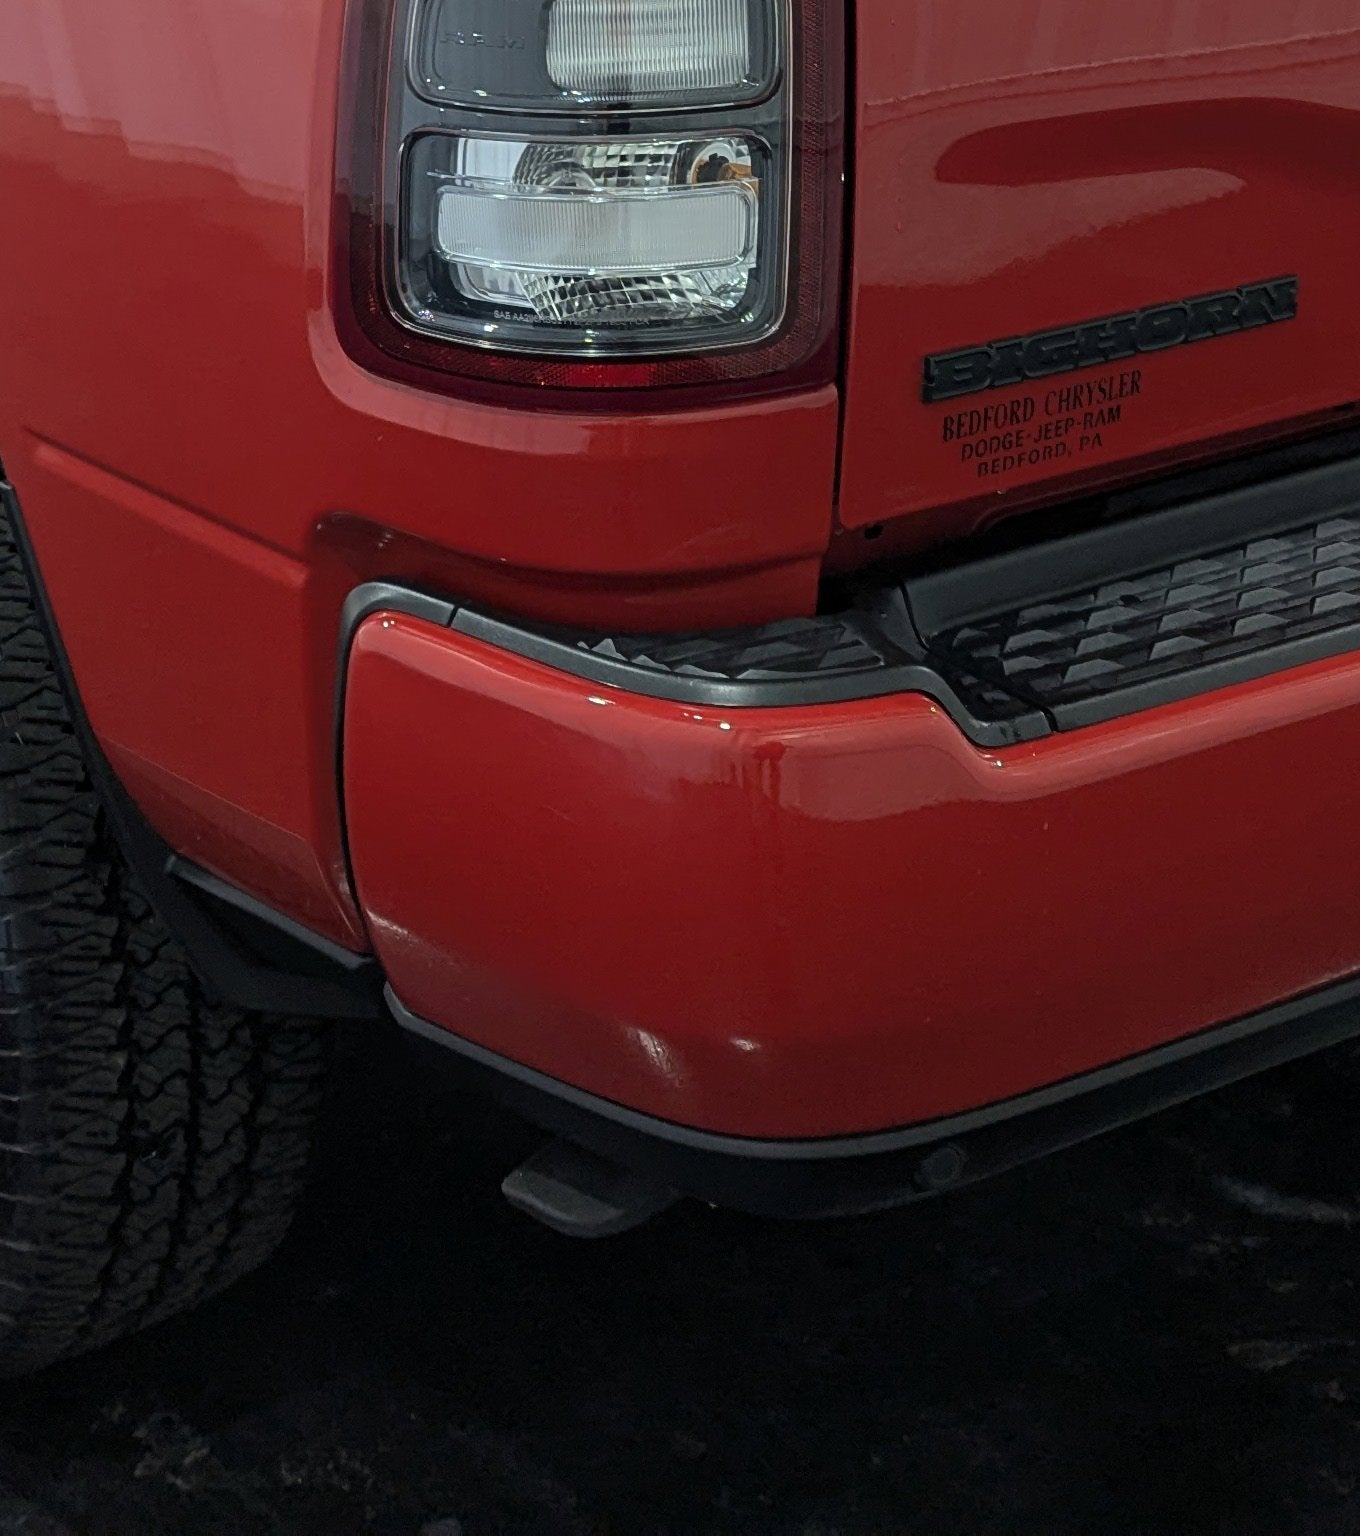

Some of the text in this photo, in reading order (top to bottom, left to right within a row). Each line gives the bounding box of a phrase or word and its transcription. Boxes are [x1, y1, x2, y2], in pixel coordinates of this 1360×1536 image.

[942, 369, 1143, 442] BEDFORD CHRYSLER
[976, 432, 1104, 478] BEDFORD, PA
